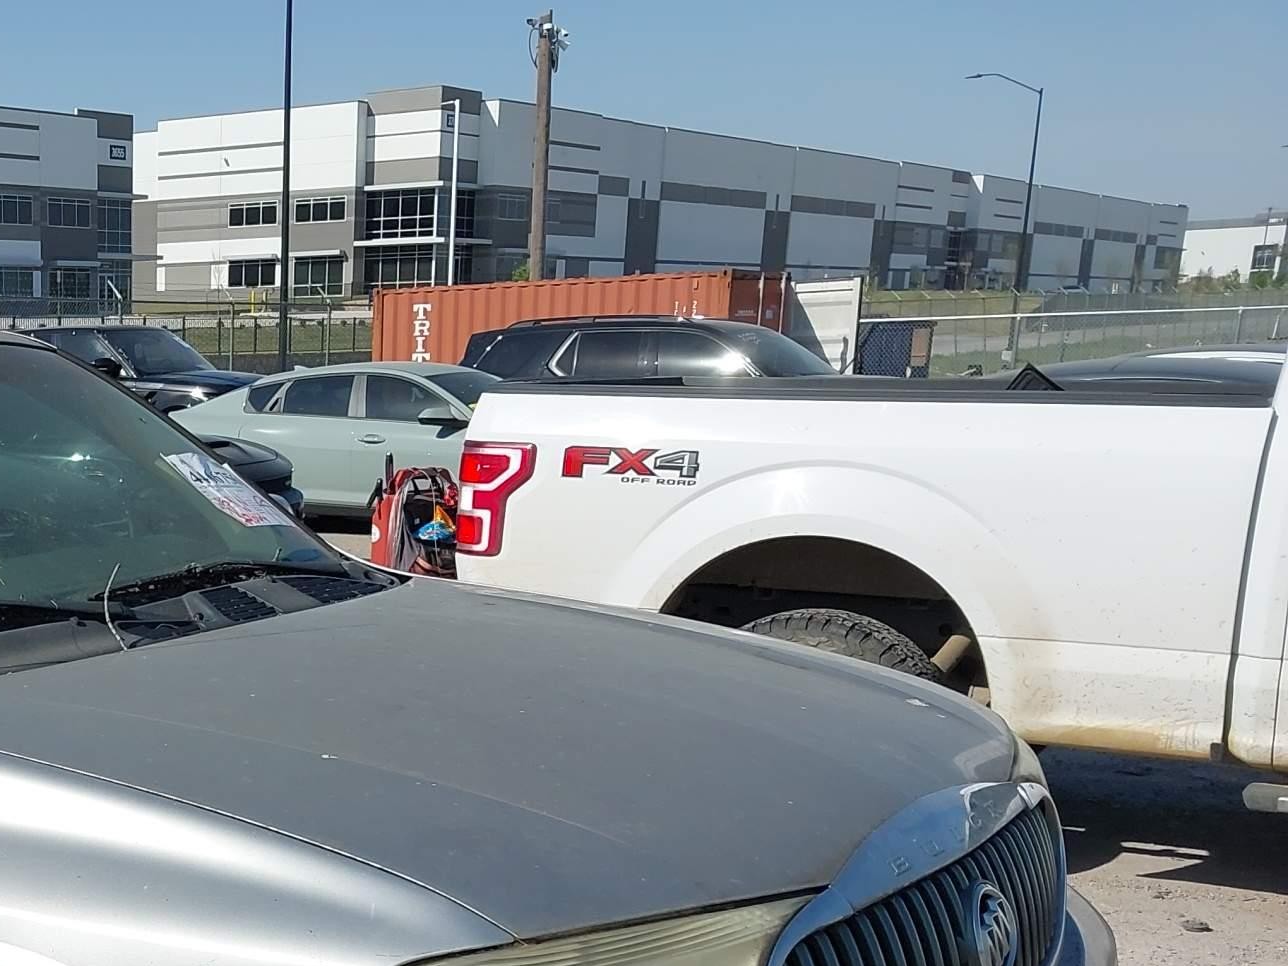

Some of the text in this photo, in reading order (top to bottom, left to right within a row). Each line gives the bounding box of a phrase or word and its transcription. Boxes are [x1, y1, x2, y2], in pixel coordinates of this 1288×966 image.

[561, 445, 700, 479] FX4
[620, 476, 697, 487] OFF ROAD
